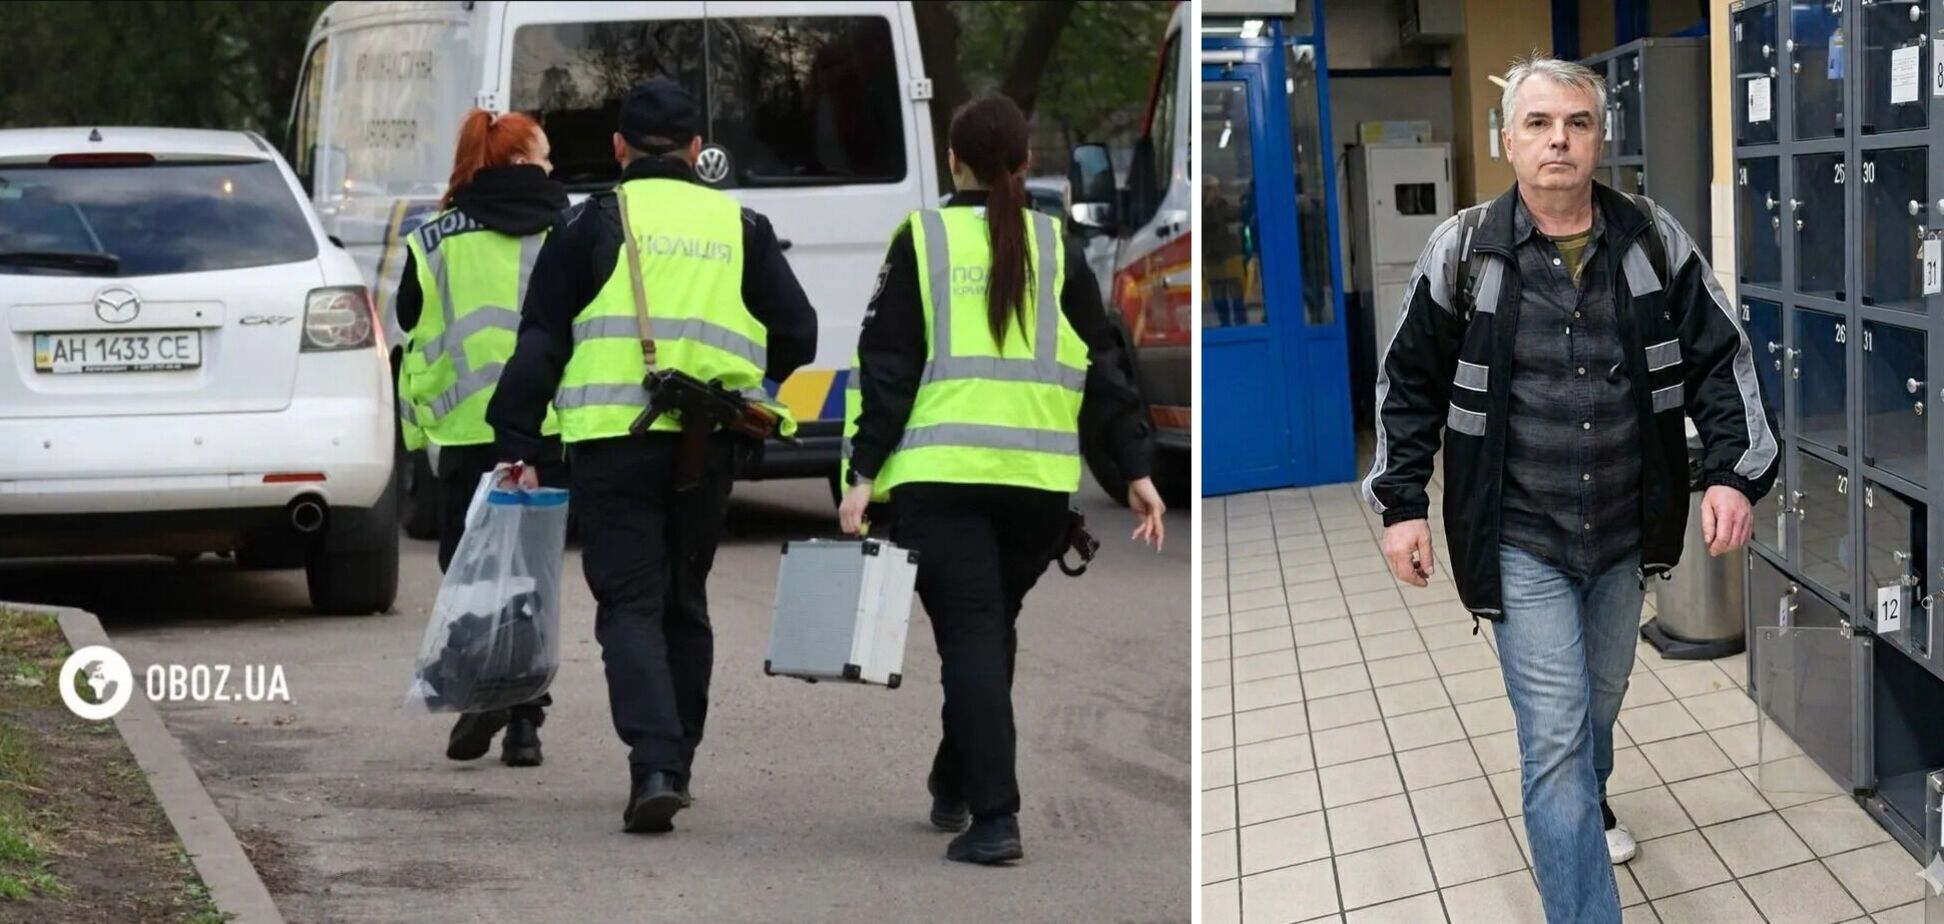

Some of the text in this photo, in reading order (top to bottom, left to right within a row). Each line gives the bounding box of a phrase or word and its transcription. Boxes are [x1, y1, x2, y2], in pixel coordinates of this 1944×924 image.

[1863, 161, 1875, 184] 30
[1835, 323, 1846, 344] 26
[1863, 331, 1872, 352] 31
[96, 337, 150, 361] 1433
[1882, 598, 1898, 621] 12
